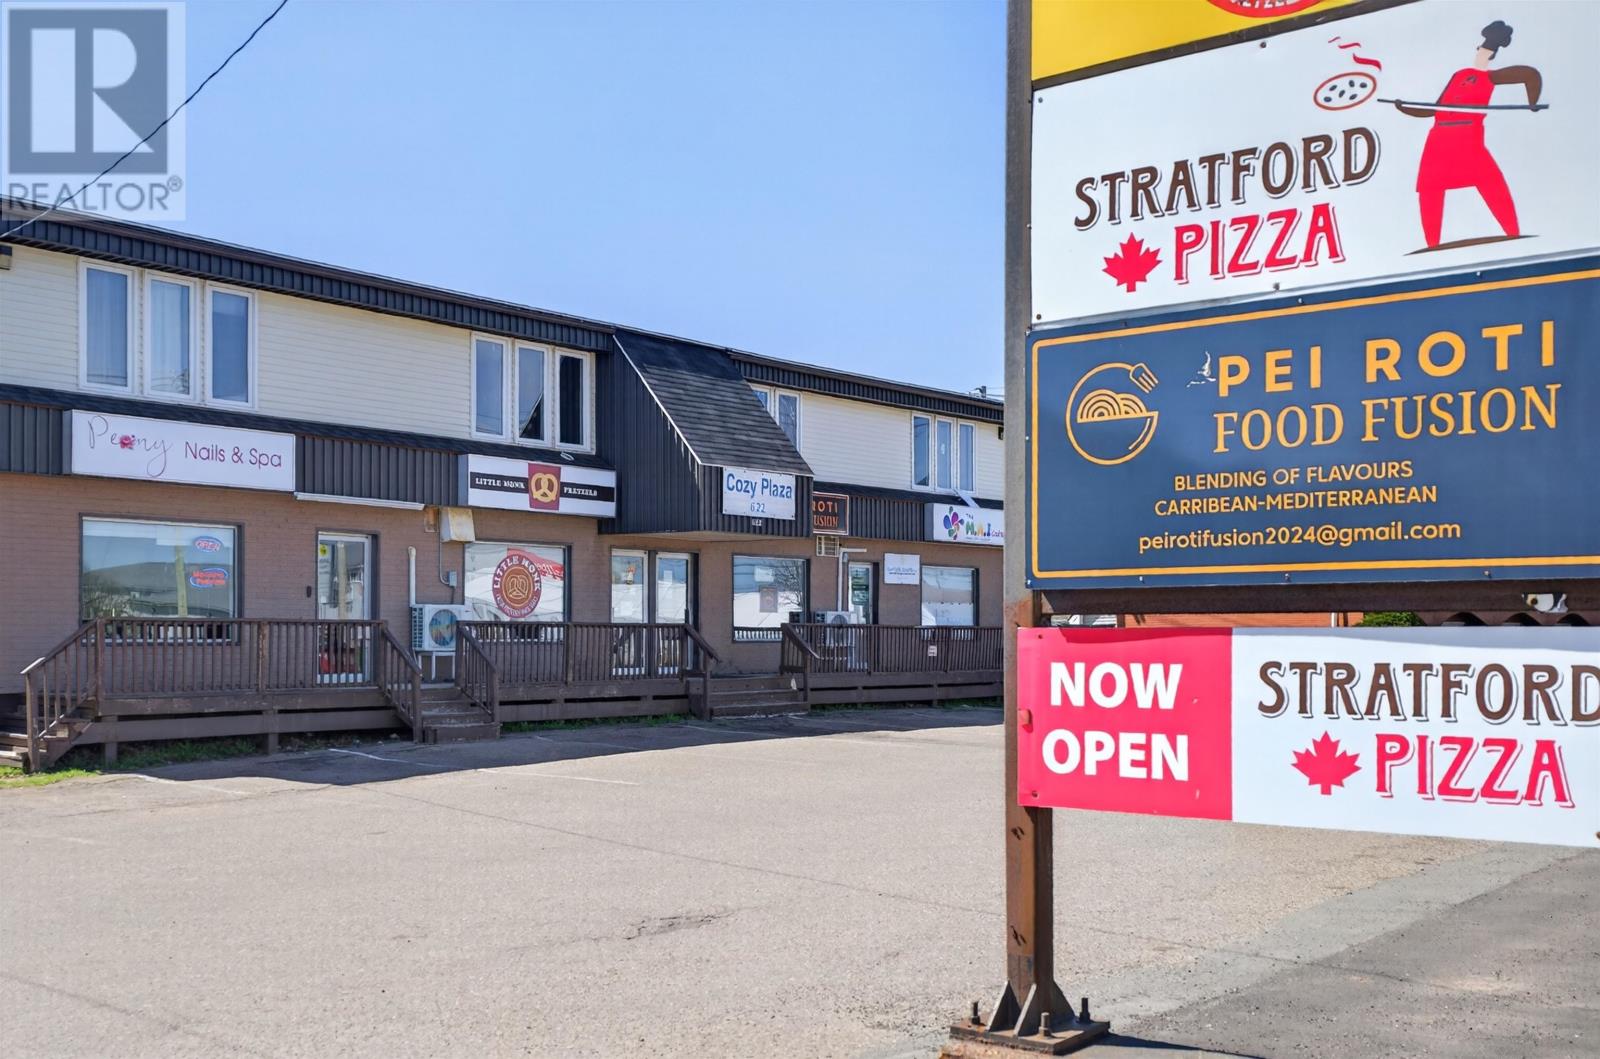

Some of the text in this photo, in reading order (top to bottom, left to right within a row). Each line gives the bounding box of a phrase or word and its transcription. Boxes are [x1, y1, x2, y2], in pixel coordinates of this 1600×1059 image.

[1074, 126, 1382, 231] STRATFORD
[1174, 202, 1346, 284] PIZZA
[1217, 320, 1555, 397] PEI ROTI
[1213, 384, 1562, 454] FOOD FUSION
[184, 441, 226, 463] Nails
[231, 447, 244, 464] &
[249, 447, 282, 470] Spa
[1174, 461, 1413, 492] BLENDING OF FLAVOURS
[475, 477, 501, 487] LITTLE
[726, 473, 793, 499] Cozy Plaza
[1154, 486, 1438, 517] CARRIBEAN-MEDITERRANEAN
[750, 502, 766, 514] 622
[1138, 521, 1462, 554] peirotifusion2024@gmail.com
[493, 555, 519, 589] LITTLE
[521, 557, 541, 592] MONK
[1049, 662, 1183, 711] NOW
[1257, 661, 1600, 728] STRATFORD
[1042, 730, 1189, 781] OPEN
[1375, 733, 1575, 808] PIZZA
